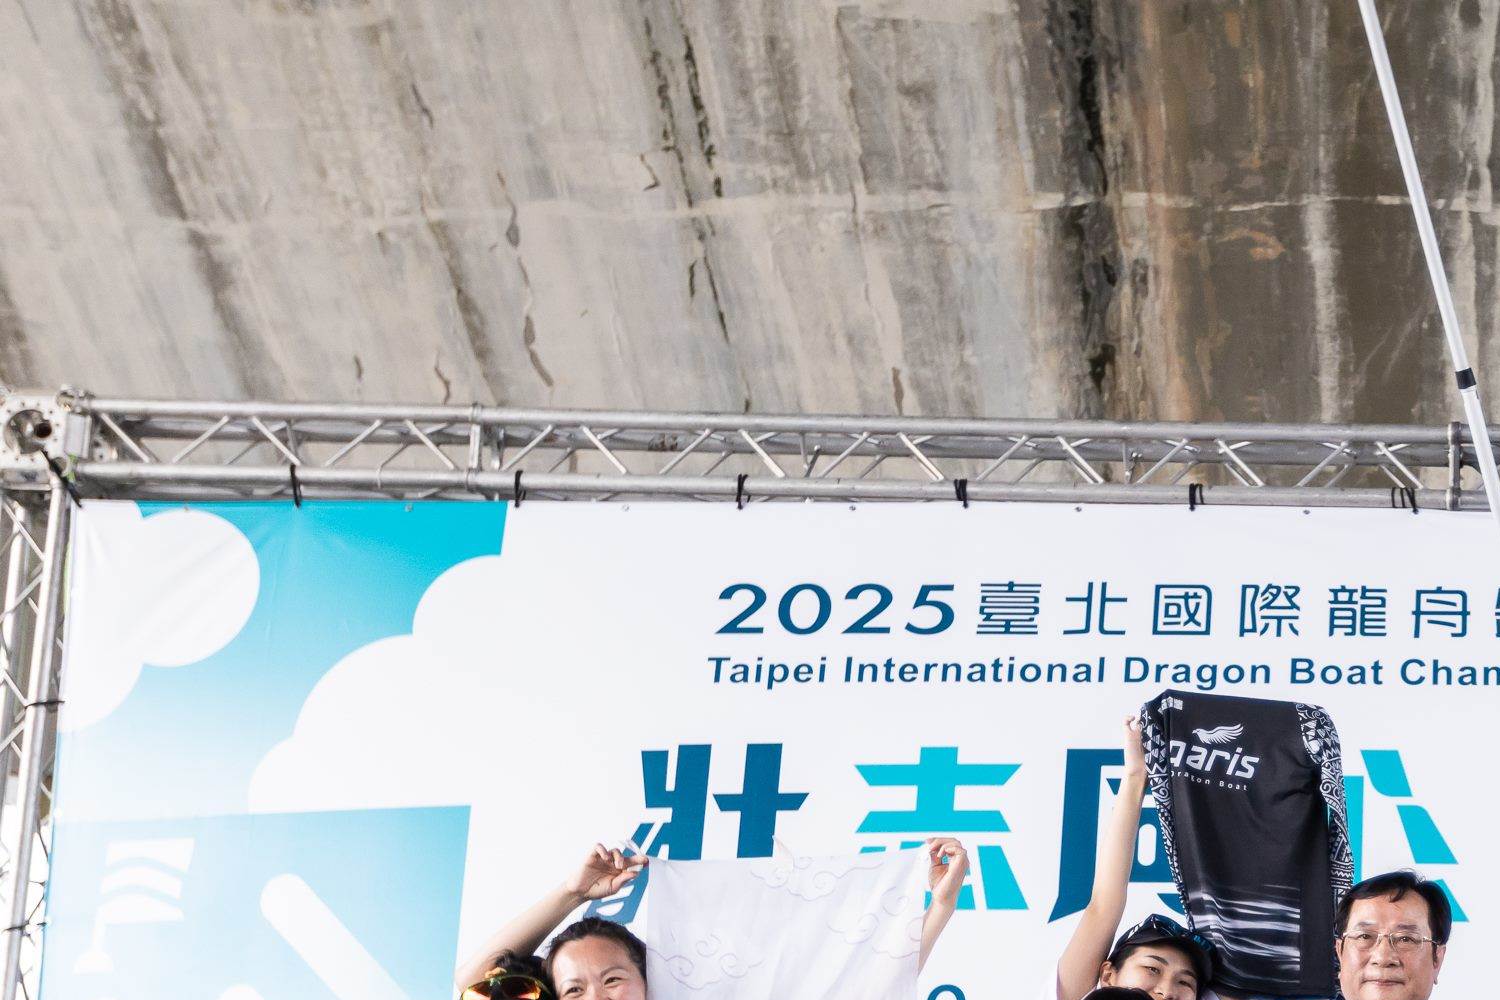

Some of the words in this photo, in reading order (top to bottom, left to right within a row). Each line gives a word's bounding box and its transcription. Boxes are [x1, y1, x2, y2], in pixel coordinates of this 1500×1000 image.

[706, 656, 828, 691] Taipei
[843, 656, 1106, 685] International
[1122, 656, 1272, 691] Dragon
[1289, 657, 1384, 687] Boat
